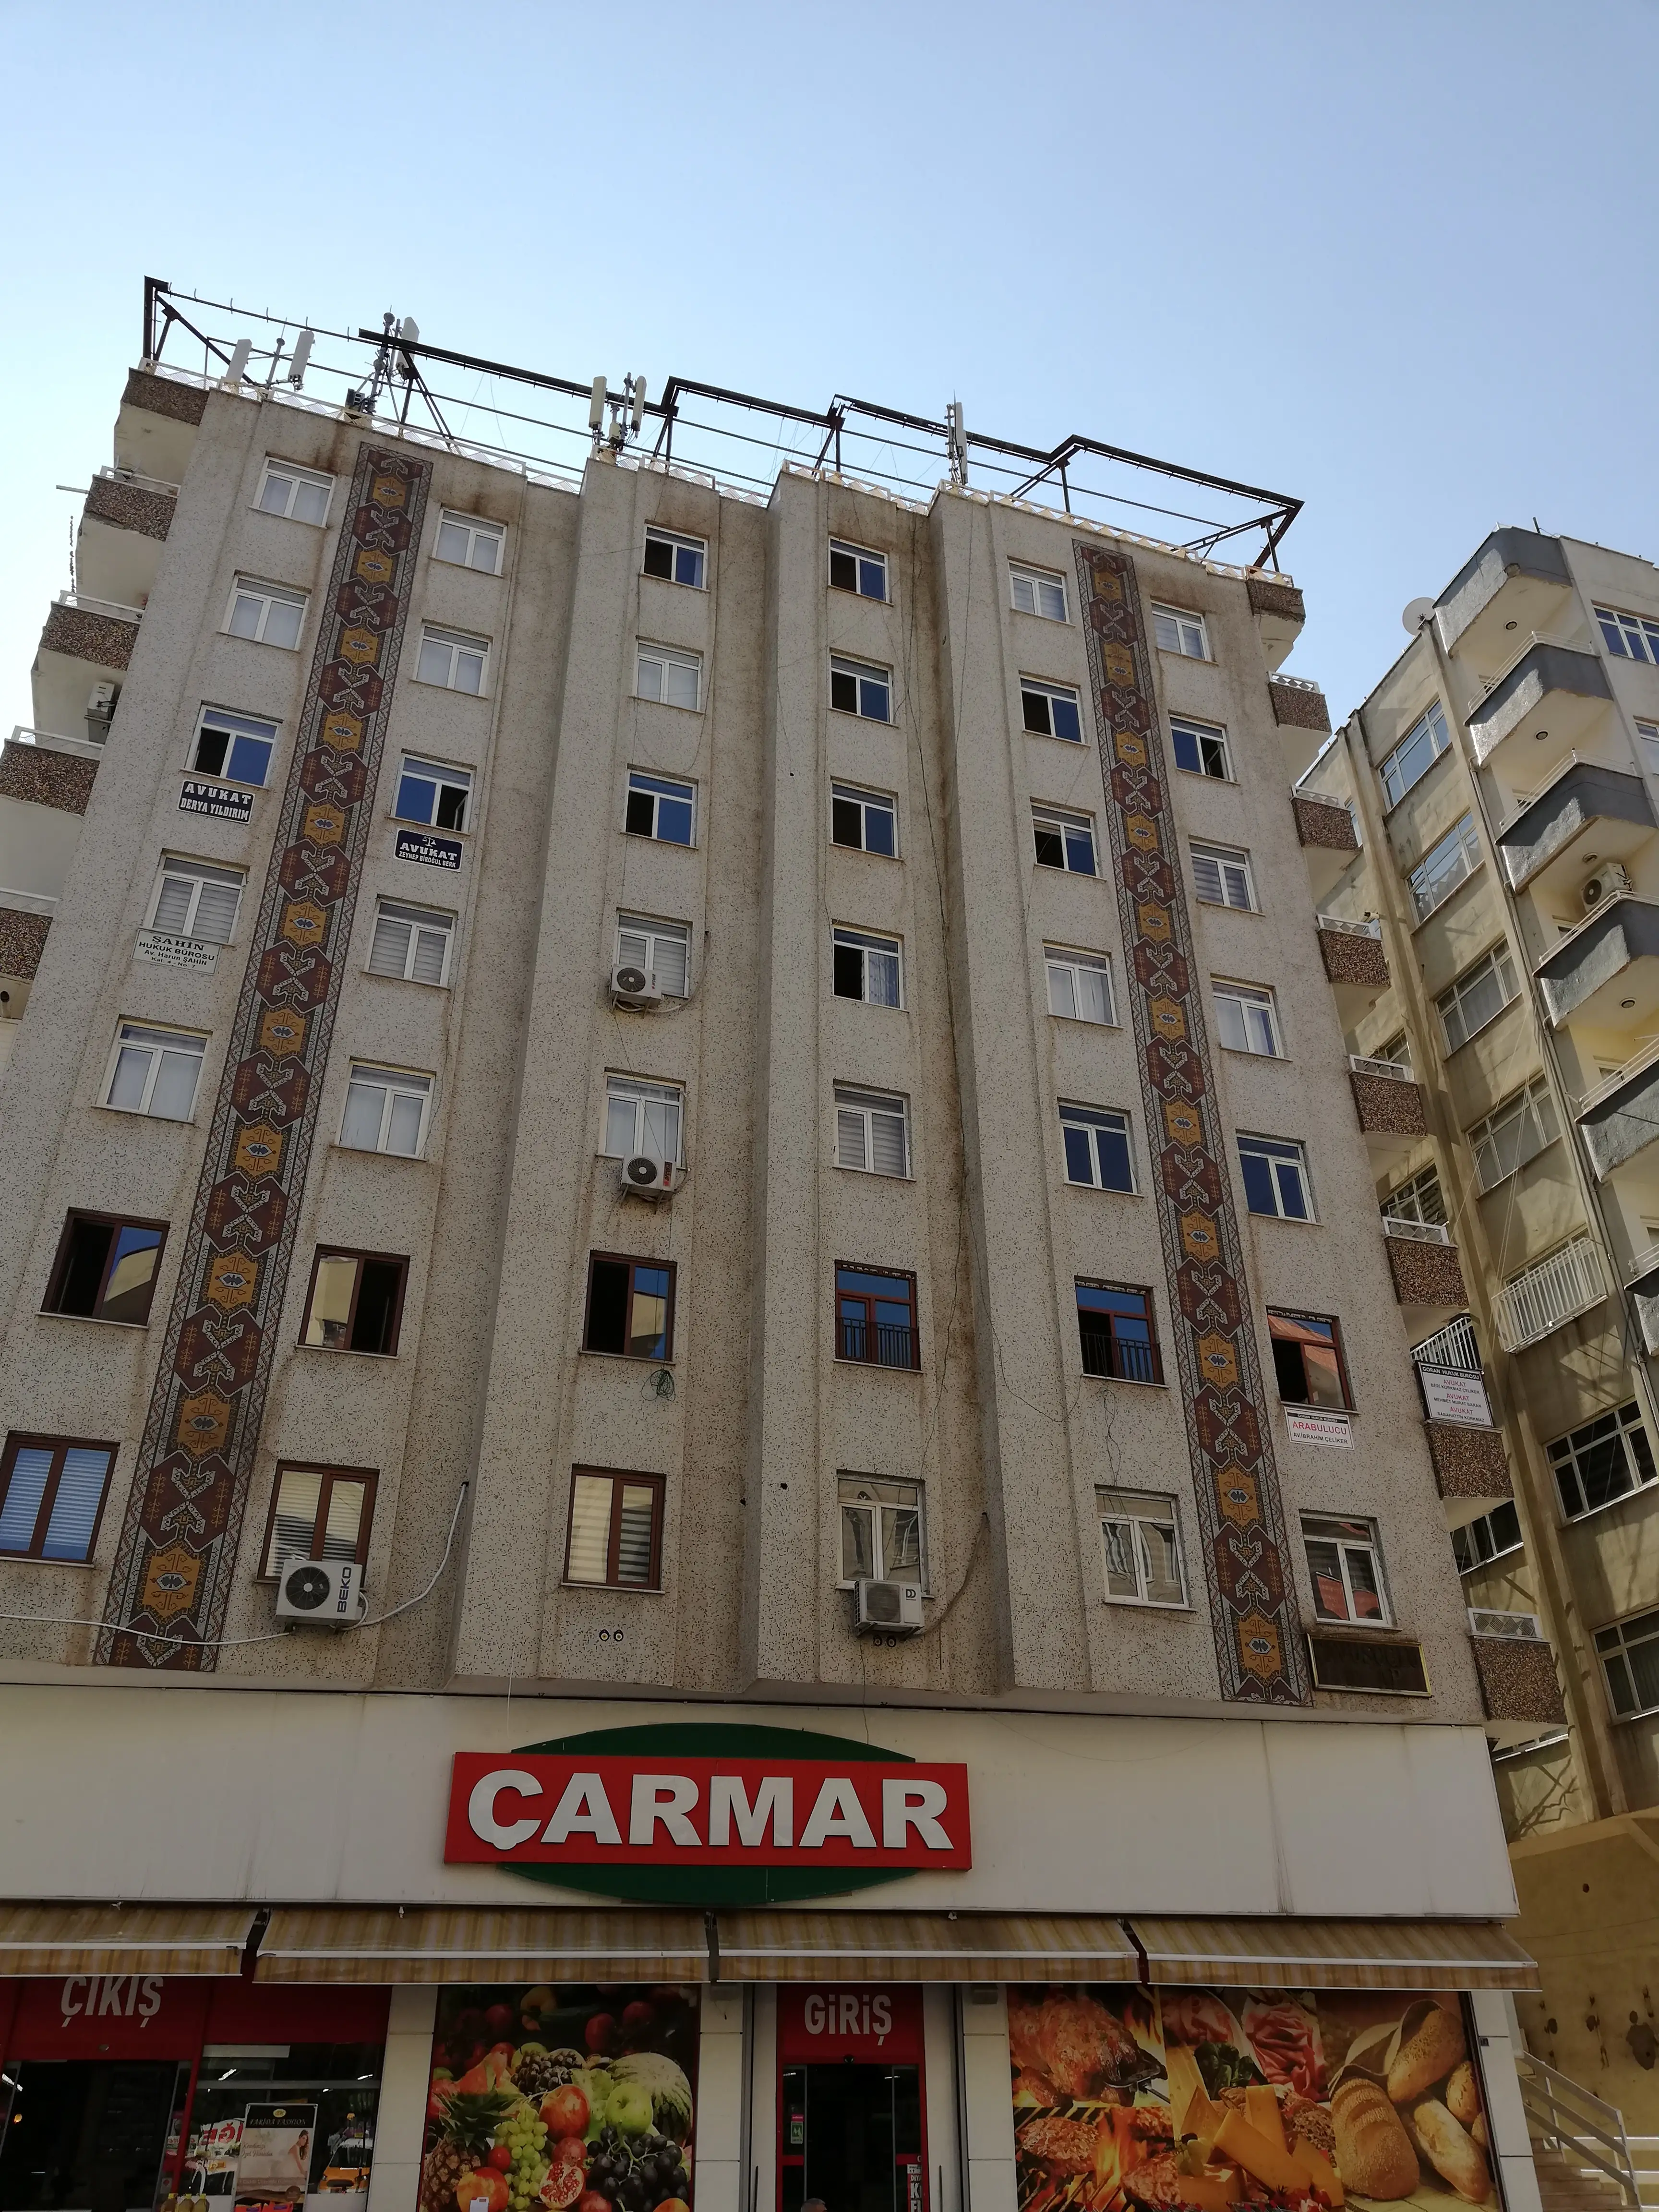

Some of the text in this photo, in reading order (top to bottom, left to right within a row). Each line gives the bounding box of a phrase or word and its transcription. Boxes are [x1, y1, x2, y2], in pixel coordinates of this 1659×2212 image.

[185, 783, 251, 805] AVUKAT
[180, 798, 249, 820] DERYA YILDIRIM
[398, 851, 419, 860] ZEYNEP
[419, 855, 442, 865] BİROĞUL
[400, 842, 457, 861] AVUKAT
[139, 941, 215, 961] HUKUK BÜROSU
[152, 936, 205, 951] ŞAHİN
[158, 951, 180, 961] Harun
[183, 957, 207, 966] ŞAHİN
[1443, 1379, 1466, 1387] AVUKAT
[1446, 1393, 1469, 1401] AVUKAT
[1450, 1407, 1473, 1415] AVUKAT
[1292, 1421, 1347, 1435] ARABULUCU
[337, 1566, 352, 1613] BEKO
[60, 1976, 165, 2028] ÇIKIŞ
